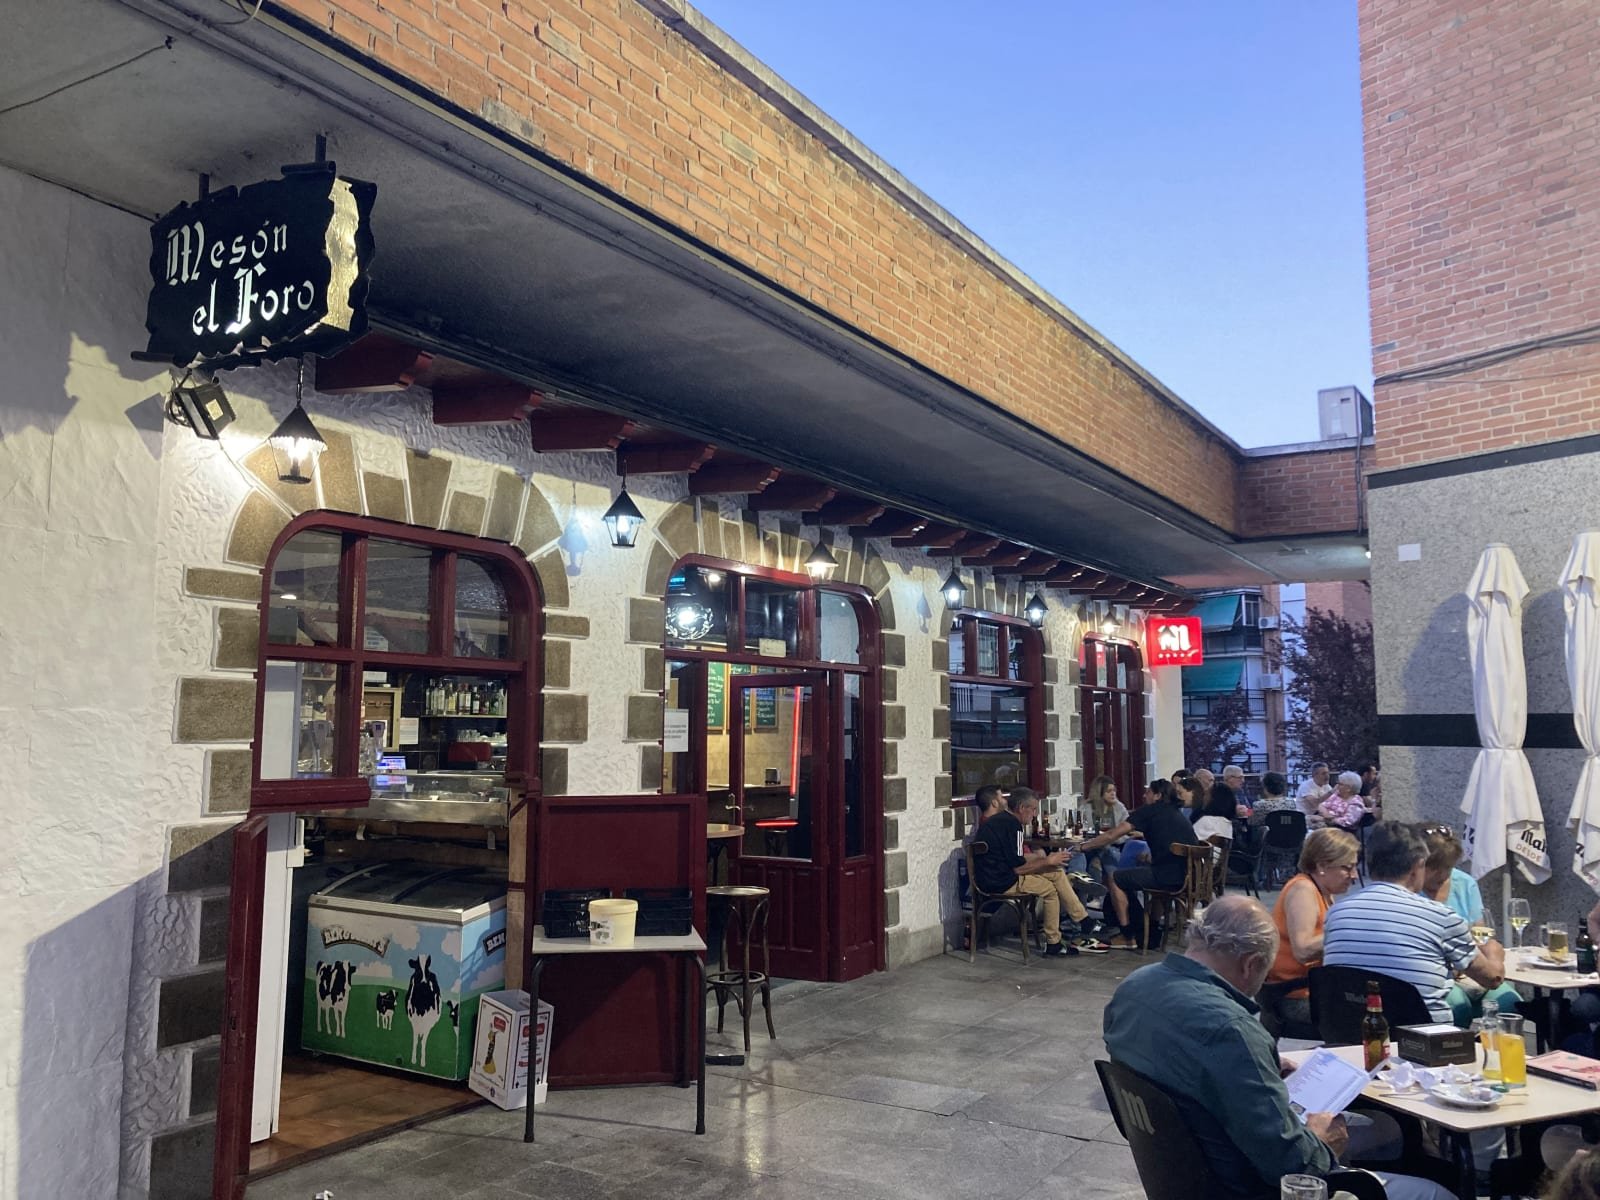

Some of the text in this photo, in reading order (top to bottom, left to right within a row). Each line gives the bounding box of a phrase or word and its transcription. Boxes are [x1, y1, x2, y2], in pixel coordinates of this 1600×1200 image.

[167, 220, 287, 286] Mesón
[192, 262, 314, 335] el Foro
